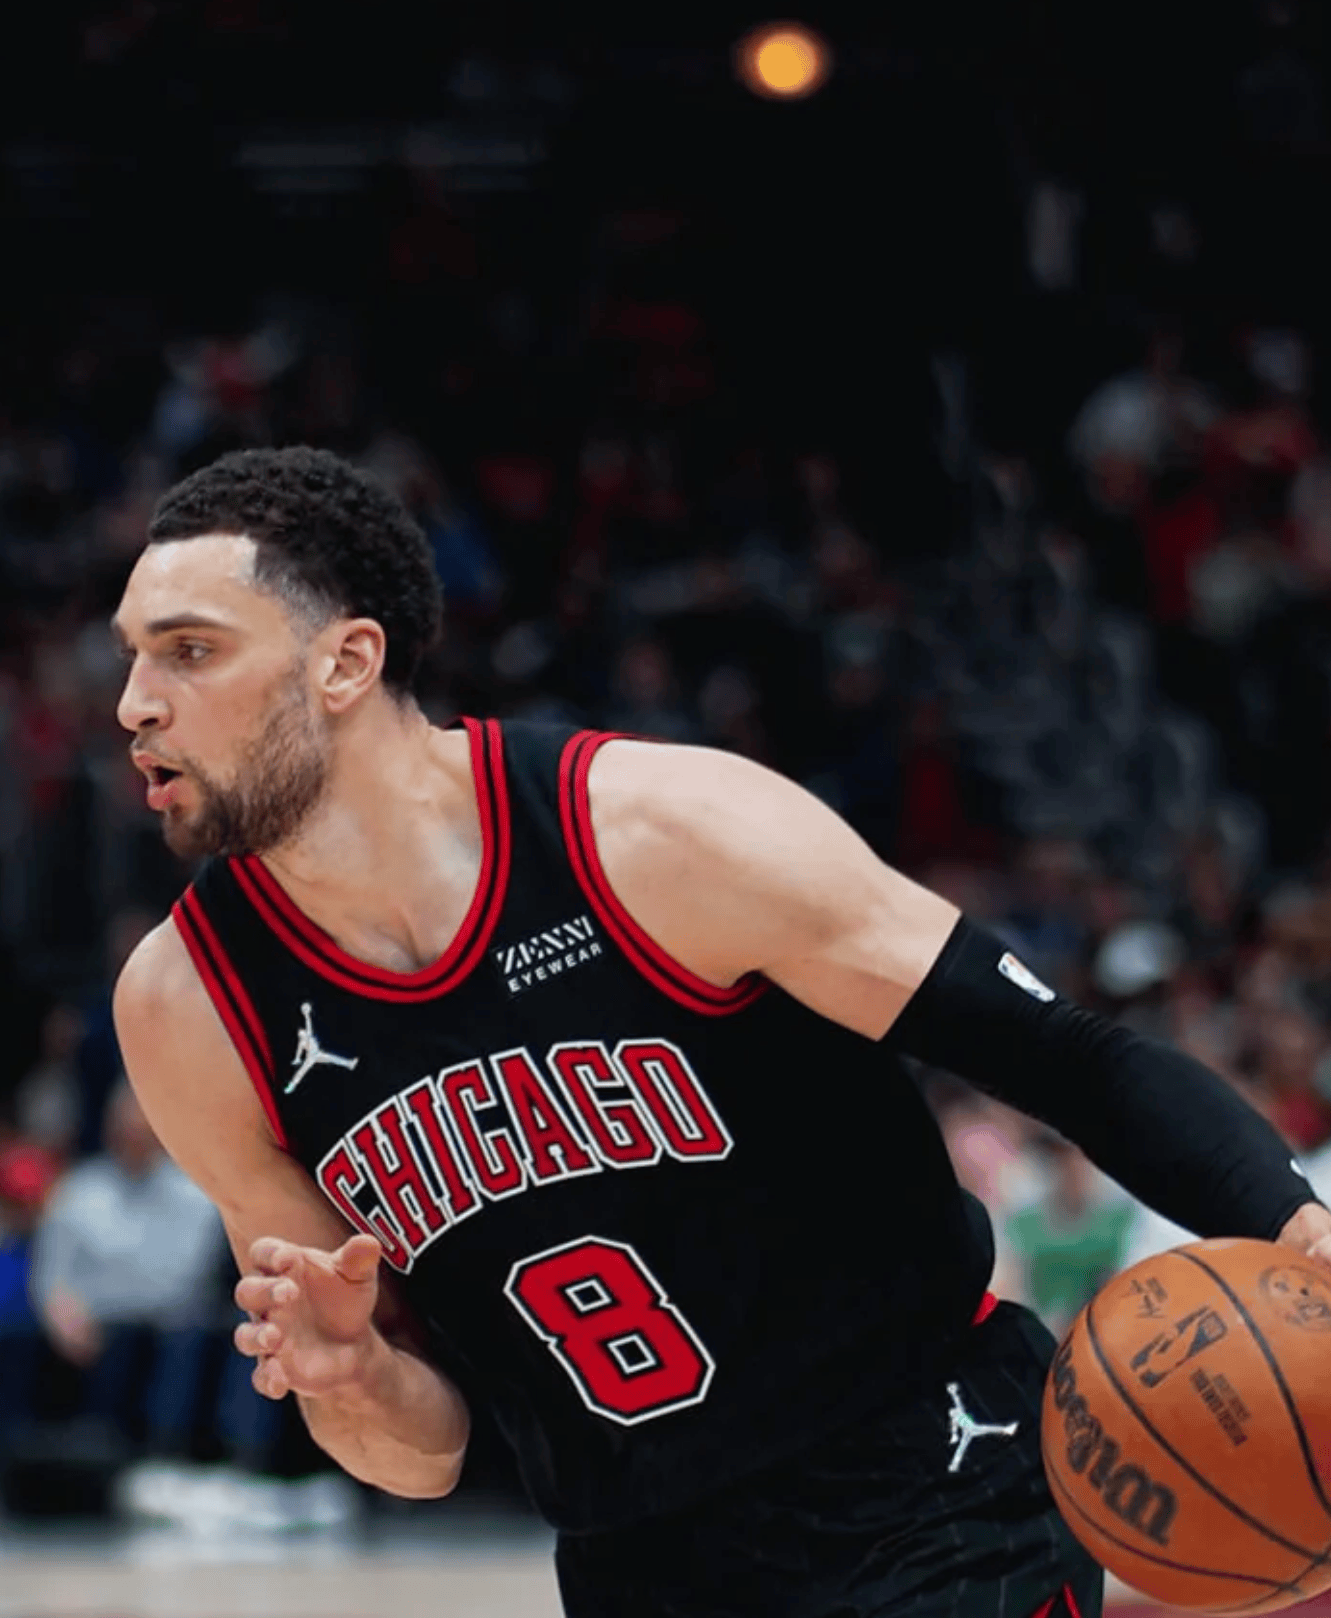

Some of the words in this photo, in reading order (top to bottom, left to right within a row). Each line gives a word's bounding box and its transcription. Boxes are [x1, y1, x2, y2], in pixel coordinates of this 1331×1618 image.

[496, 914, 595, 975] ZENNI
[508, 942, 603, 993] EYEWEAR
[316, 1037, 734, 1275] CHICAGO
[503, 1235, 716, 1426] 8
